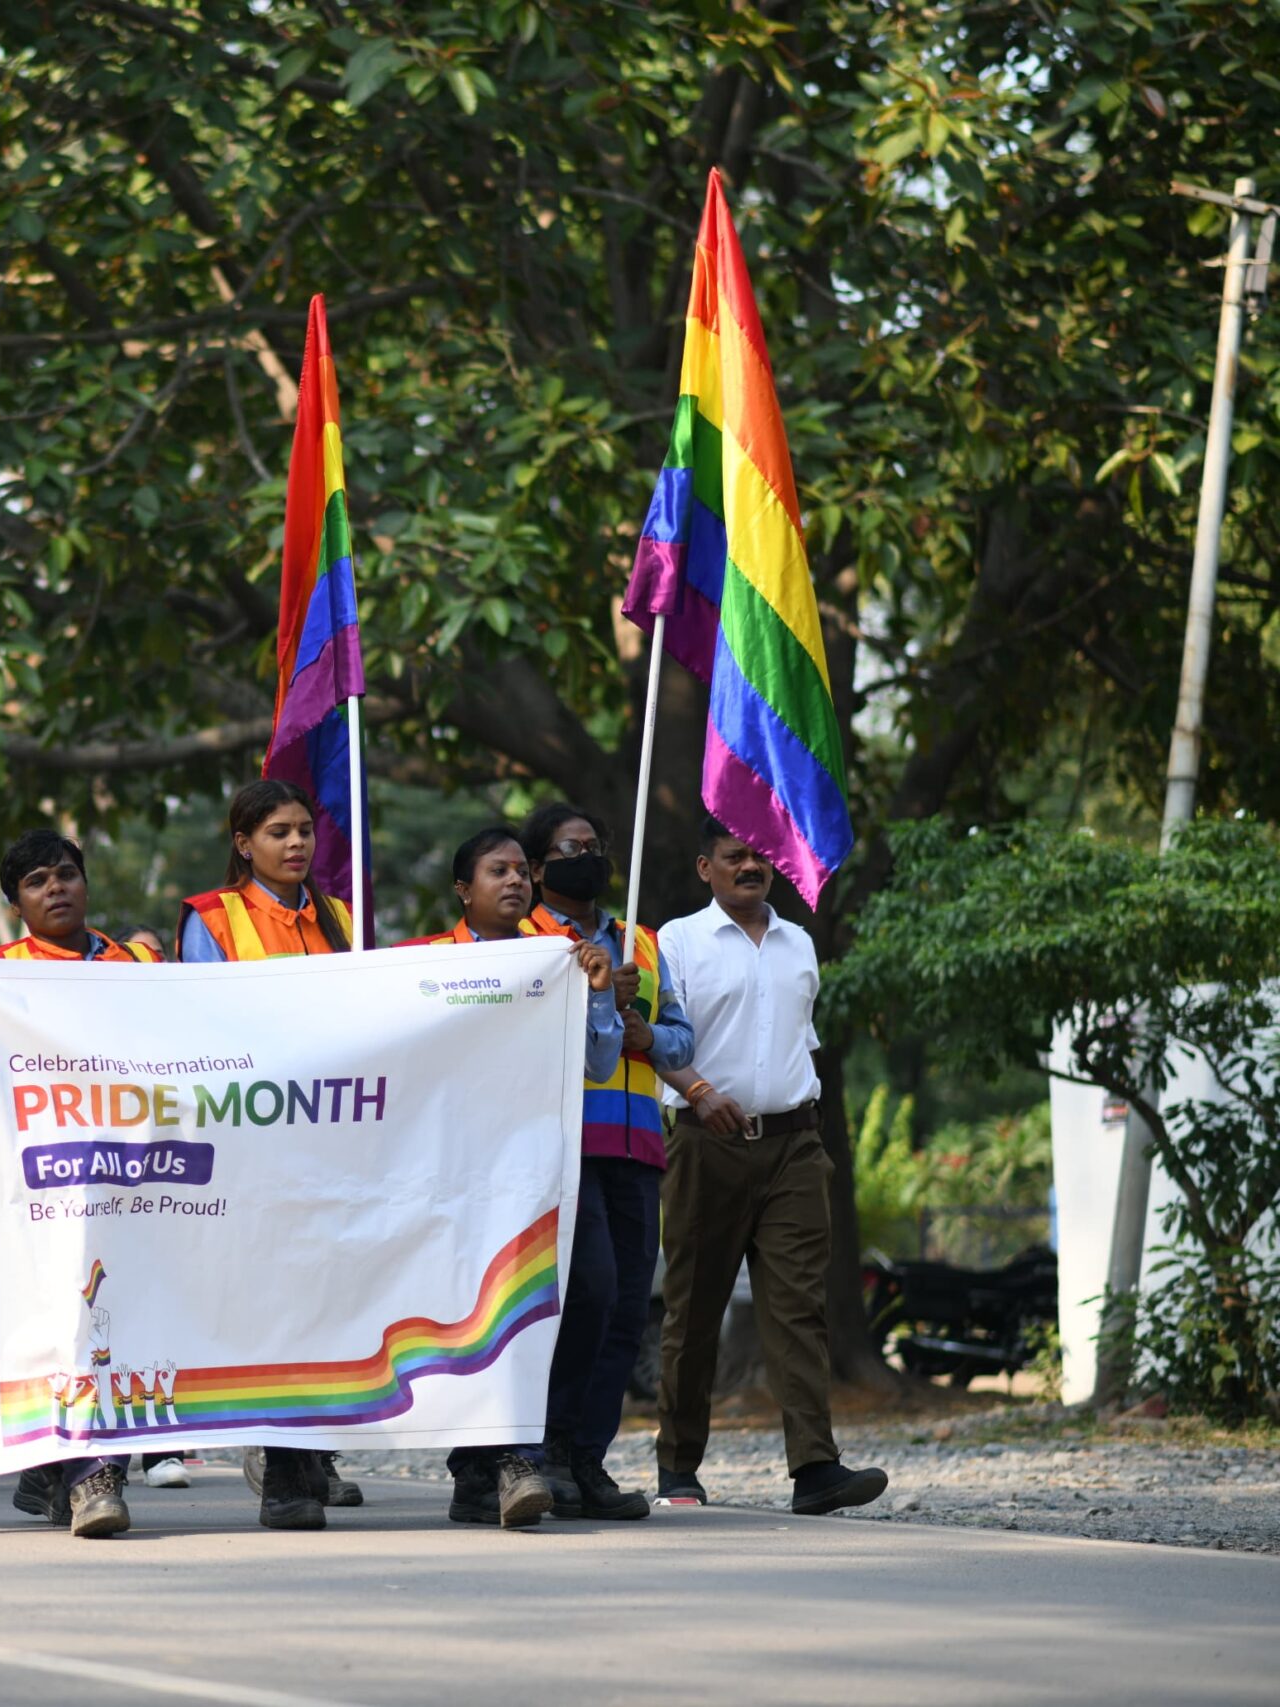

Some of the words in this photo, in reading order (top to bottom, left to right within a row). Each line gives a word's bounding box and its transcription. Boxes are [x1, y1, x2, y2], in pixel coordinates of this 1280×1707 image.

[441, 977, 501, 990] vedanta
[446, 991, 513, 1005] aluminium
[9, 1054, 129, 1075] Celebrating
[129, 1053, 254, 1075] International
[13, 1083, 180, 1131] PRIDE
[192, 1077, 386, 1127] MONTH
[36, 1155, 83, 1180] For
[90, 1151, 121, 1176] All
[125, 1152, 150, 1179] of
[152, 1150, 186, 1175] Us
[30, 1202, 56, 1221] Be
[59, 1196, 123, 1218] Yourself,
[130, 1196, 154, 1214] Be
[159, 1195, 227, 1216] Proud!
